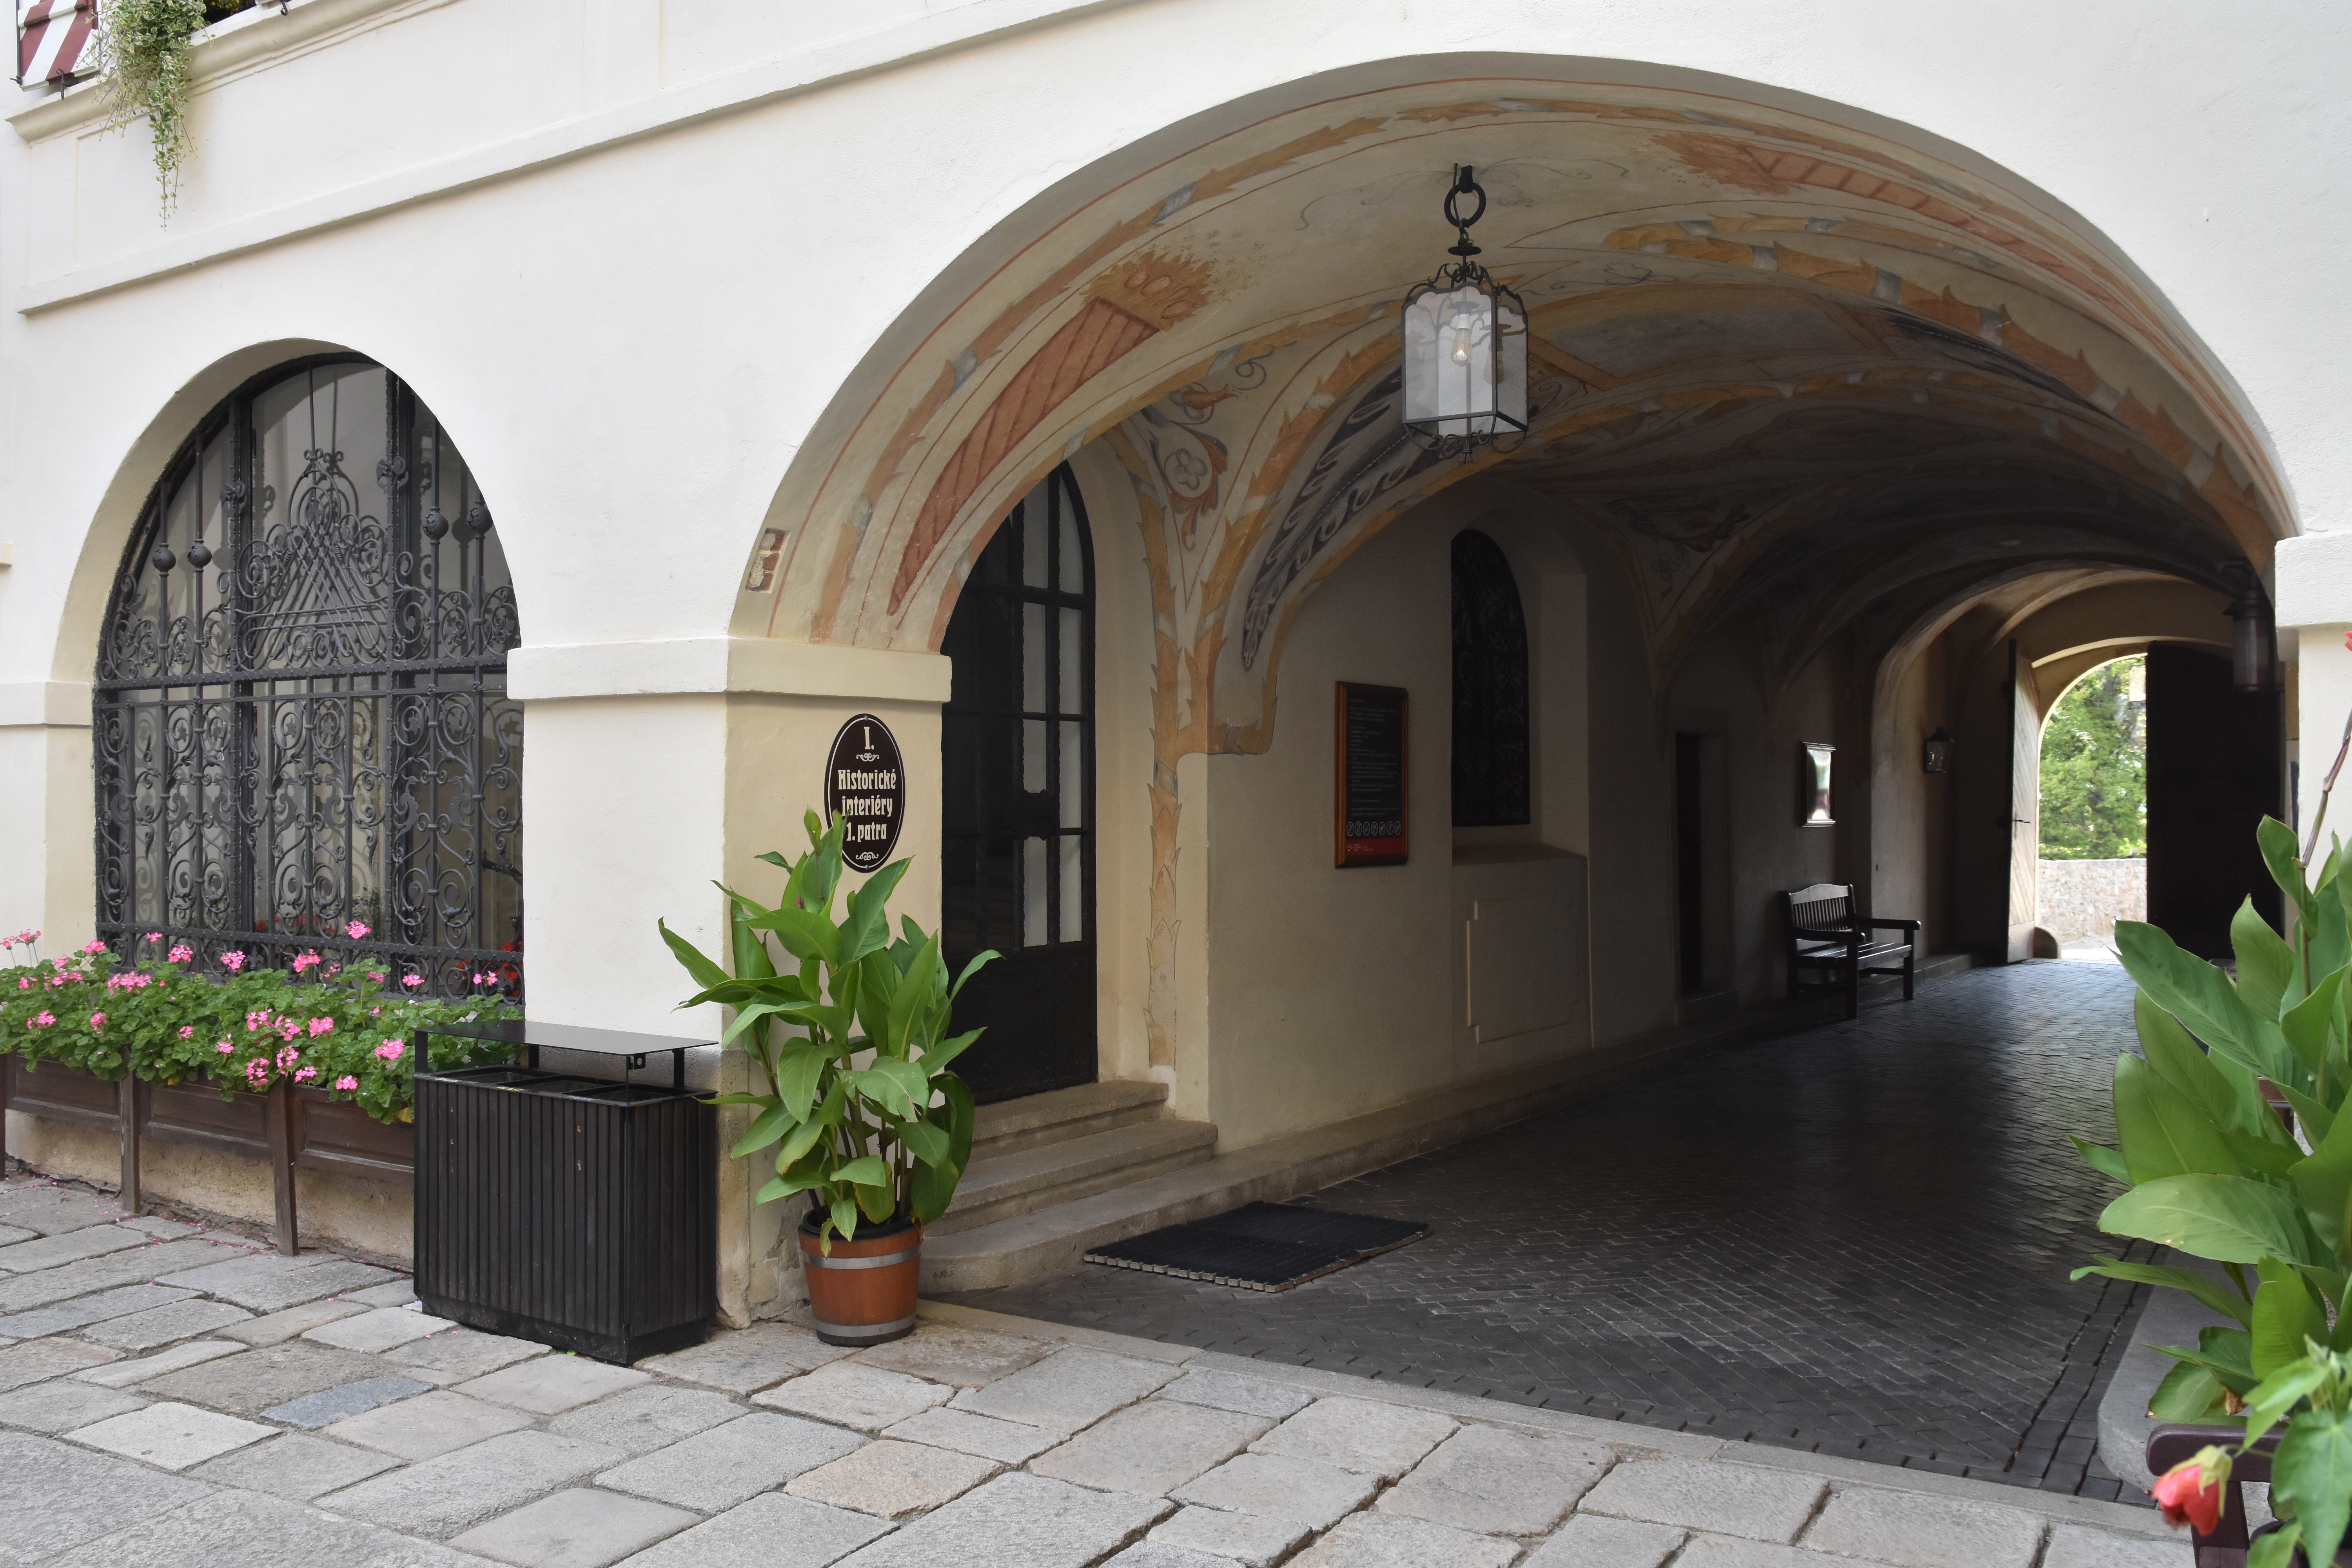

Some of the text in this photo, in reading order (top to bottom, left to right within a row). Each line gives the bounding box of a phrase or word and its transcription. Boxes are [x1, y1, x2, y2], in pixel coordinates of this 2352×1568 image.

[838, 769, 896, 790] Historické
[842, 795, 893, 817] interiéry
[846, 822, 887, 842] 1. patra
